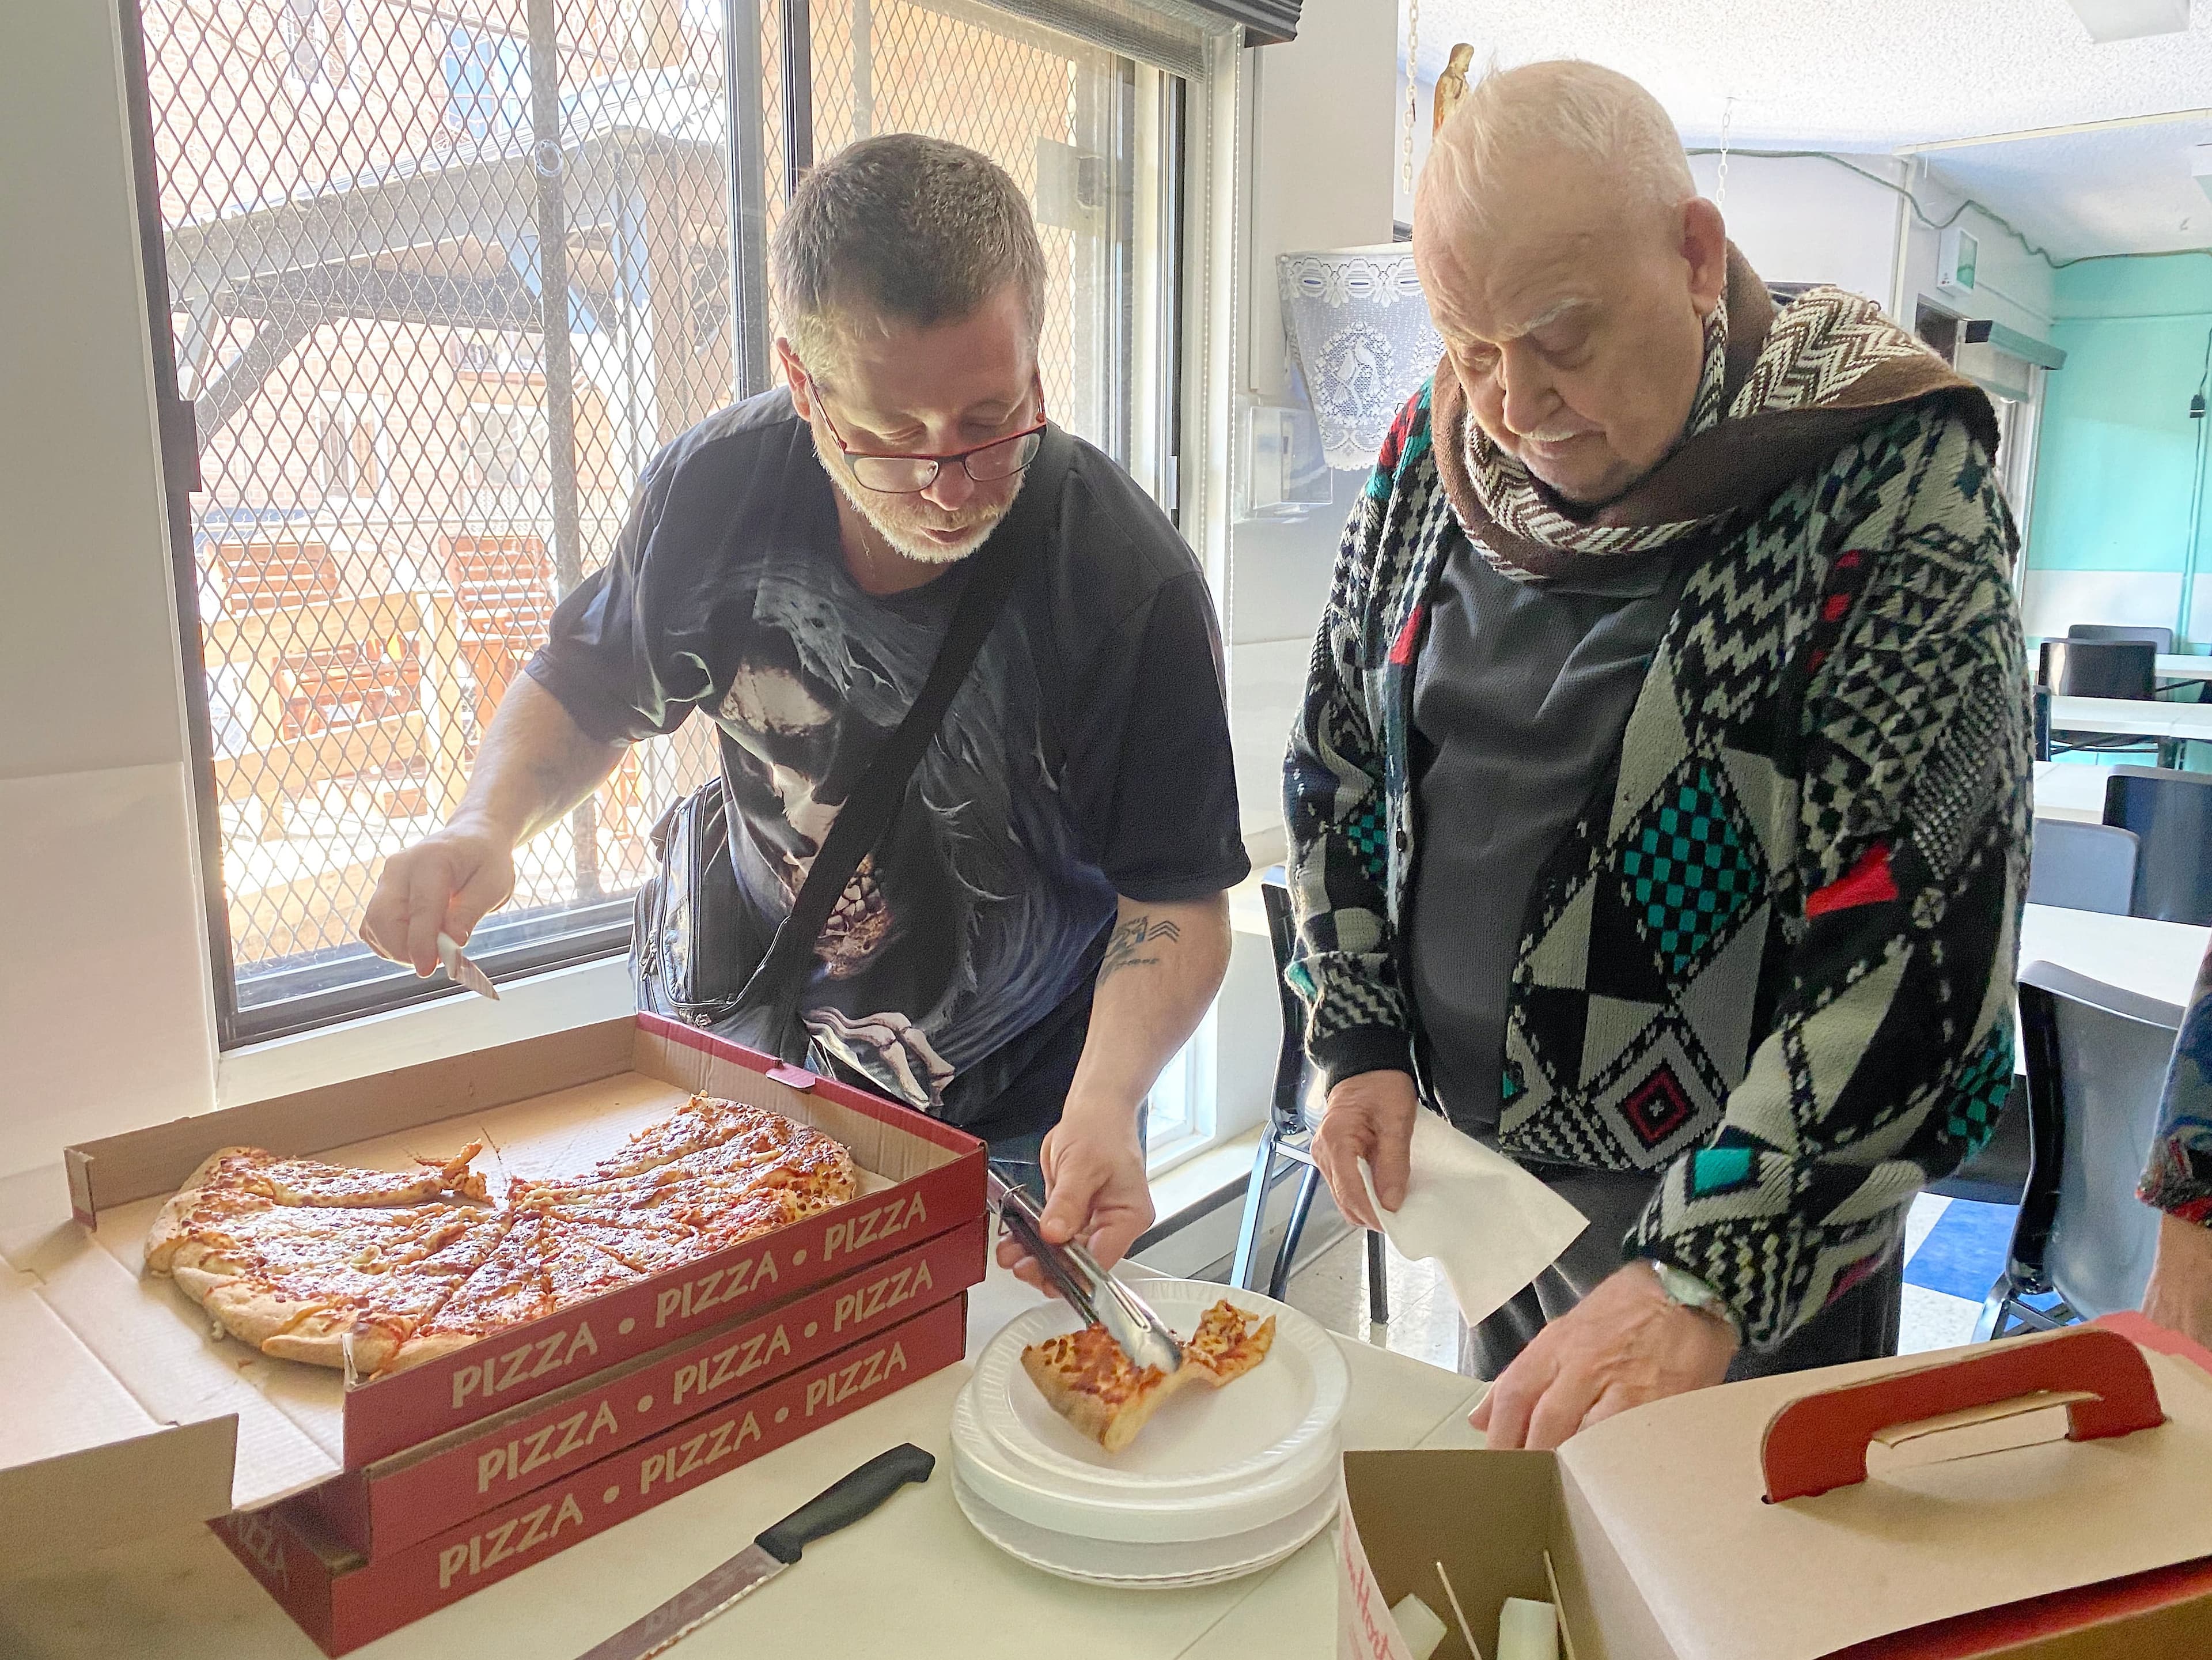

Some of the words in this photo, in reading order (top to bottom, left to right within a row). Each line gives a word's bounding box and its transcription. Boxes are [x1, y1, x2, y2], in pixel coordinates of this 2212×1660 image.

[452, 1321, 598, 1408] PIZZA
[655, 1250, 778, 1328] PIZZA
[823, 1192, 927, 1261] PIZZA
[478, 1401, 618, 1493] PIZZA
[673, 1320, 790, 1405] PIZZA
[834, 1260, 933, 1332] PIZZA
[439, 1493, 582, 1589] PIZZA
[640, 1406, 761, 1494] PIZZA
[805, 1341, 907, 1416] PIZZA
